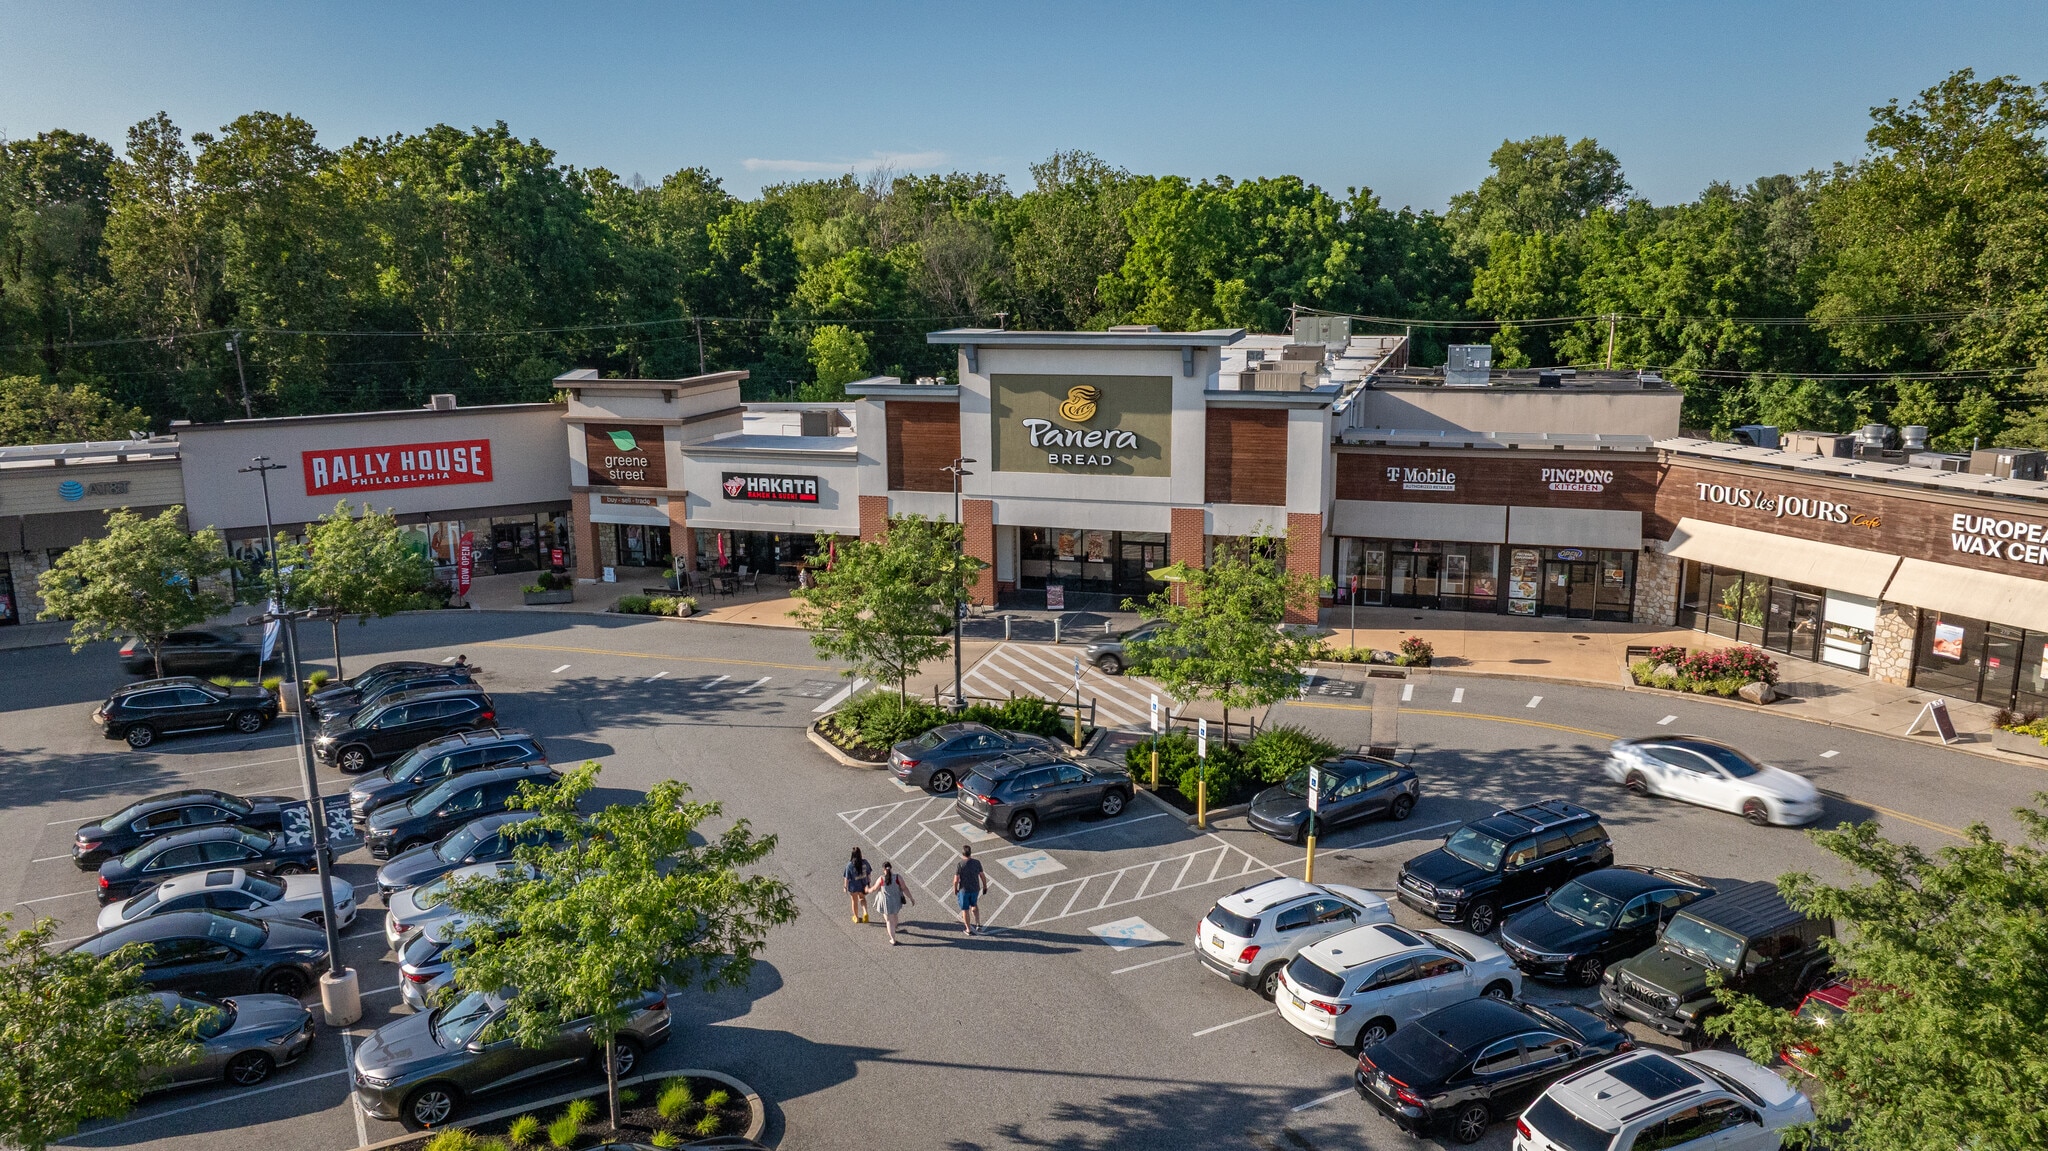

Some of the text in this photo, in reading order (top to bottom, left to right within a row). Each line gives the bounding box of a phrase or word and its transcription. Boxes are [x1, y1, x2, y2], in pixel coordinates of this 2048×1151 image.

[1022, 418, 1138, 449] Panera
[312, 446, 484, 489] RALLY HOUSE
[605, 456, 648, 468] greene
[1048, 453, 1112, 466] BREAD
[352, 472, 450, 486] PHILADELPHIA
[609, 469, 645, 481] street
[1403, 468, 1456, 484] Mobile
[1541, 468, 1614, 484] PINGPONG
[747, 477, 816, 495] HAKATA
[1554, 483, 1599, 491] KITCHEN
[1696, 482, 1751, 508] TOUS
[1754, 491, 1775, 511] les
[1776, 494, 1849, 524] JOURS
[1951, 533, 2003, 558] WAX
[461, 546, 471, 585] NOW OPEN
